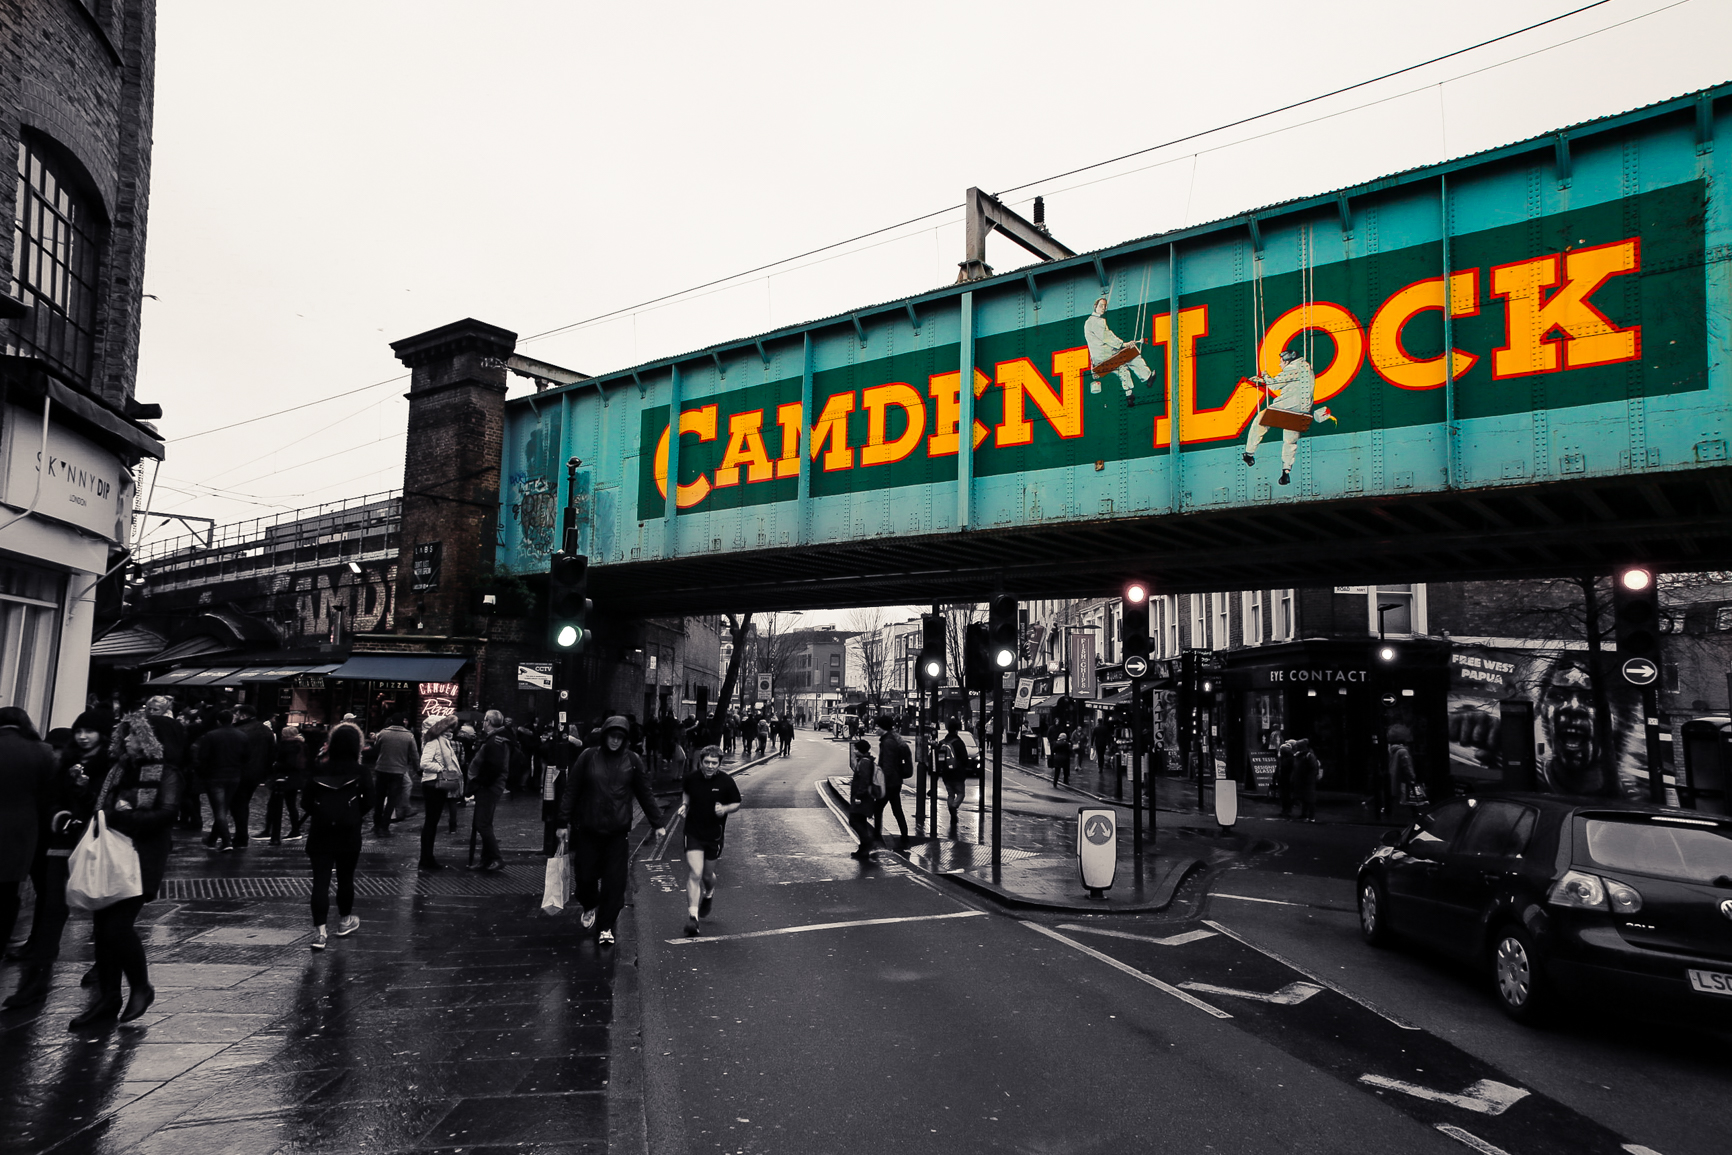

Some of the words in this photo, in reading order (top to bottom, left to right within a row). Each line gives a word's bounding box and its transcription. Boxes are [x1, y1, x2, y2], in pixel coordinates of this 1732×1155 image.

[653, 345, 1091, 509] CAMDEN
[1152, 236, 1642, 449] LOCK
[1451, 653, 1482, 668] FREE
[1482, 658, 1516, 674] WEST
[379, 681, 410, 689] PIZZA
[1270, 670, 1284, 682] EYE
[1289, 669, 1367, 682] CONTACT
[1461, 668, 1503, 685] PAPUA
[1154, 691, 1164, 750] TATTOO
